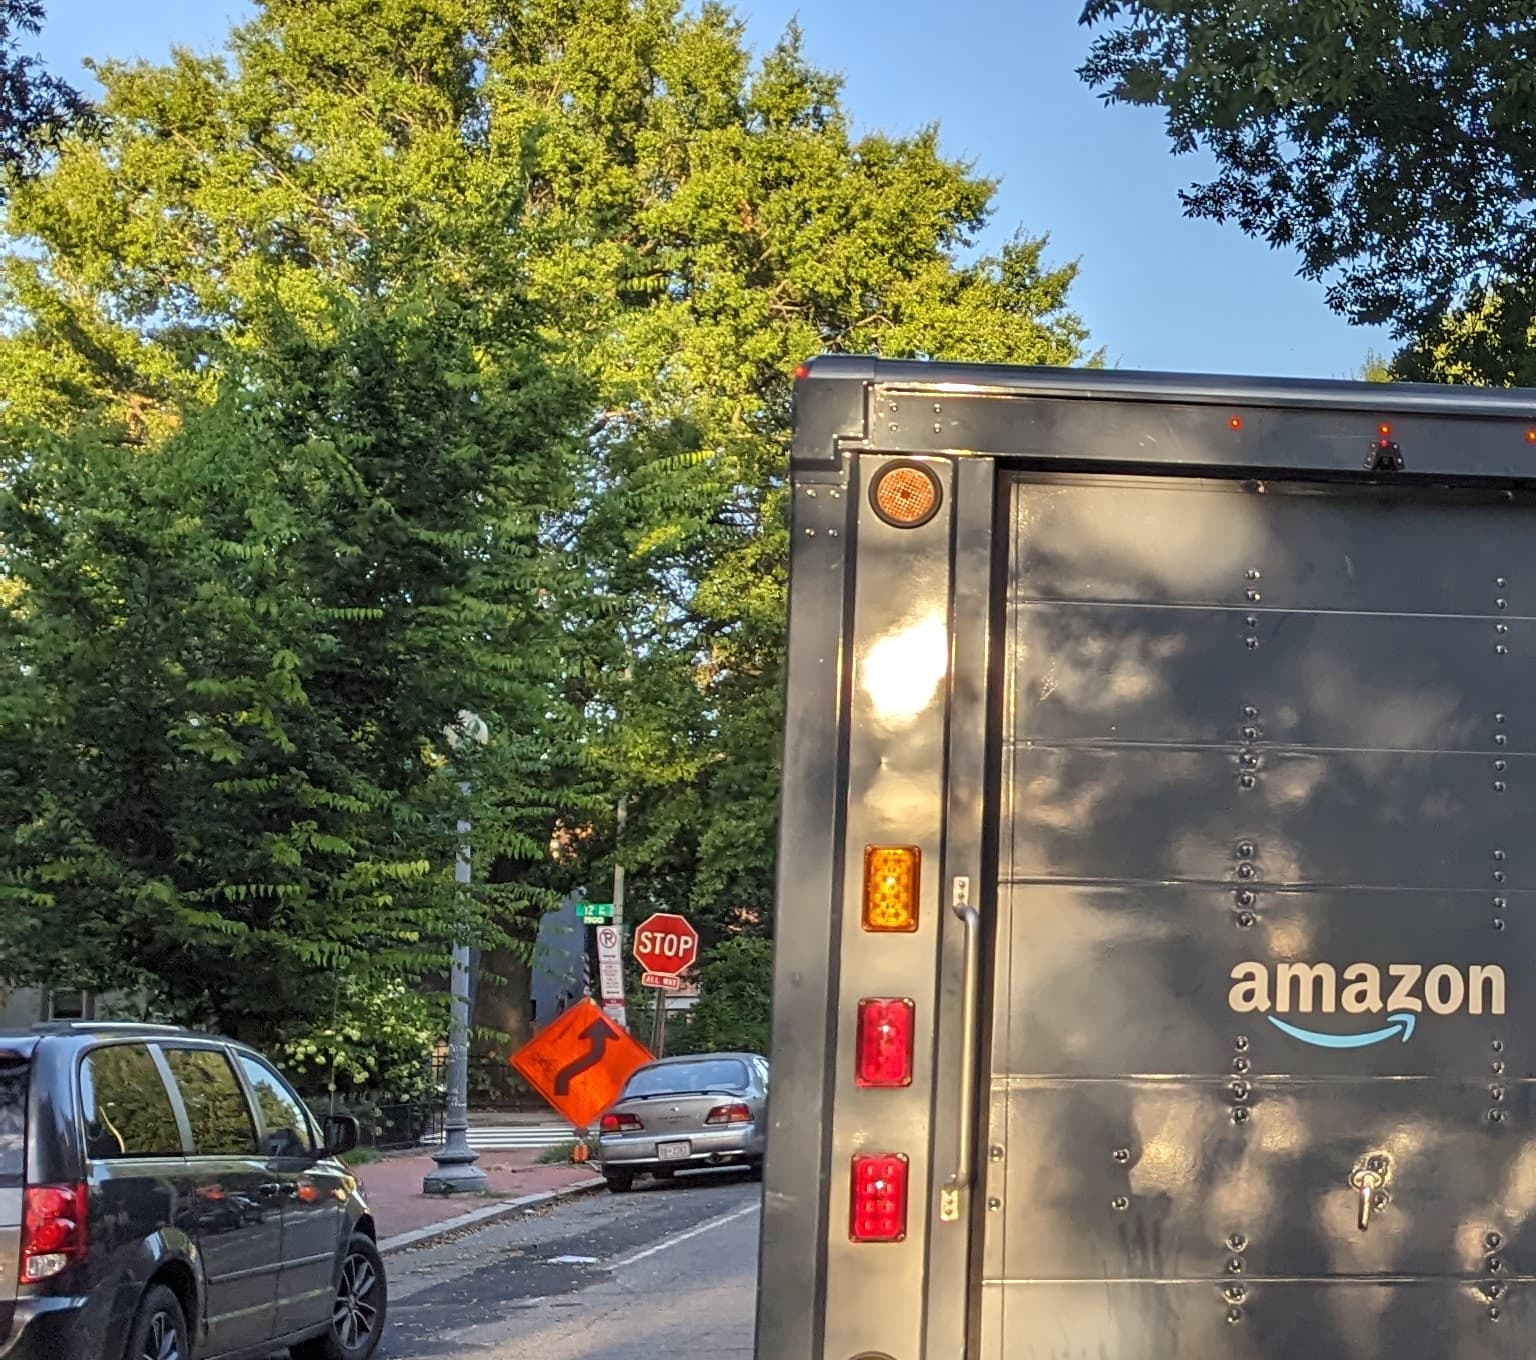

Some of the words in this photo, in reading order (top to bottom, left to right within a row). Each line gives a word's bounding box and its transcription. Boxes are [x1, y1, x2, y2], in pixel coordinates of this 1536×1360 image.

[639, 931, 692, 958] STOP
[645, 974, 660, 985] ALL
[662, 977, 678, 988] WAY
[1228, 960, 1506, 1015] amazon
